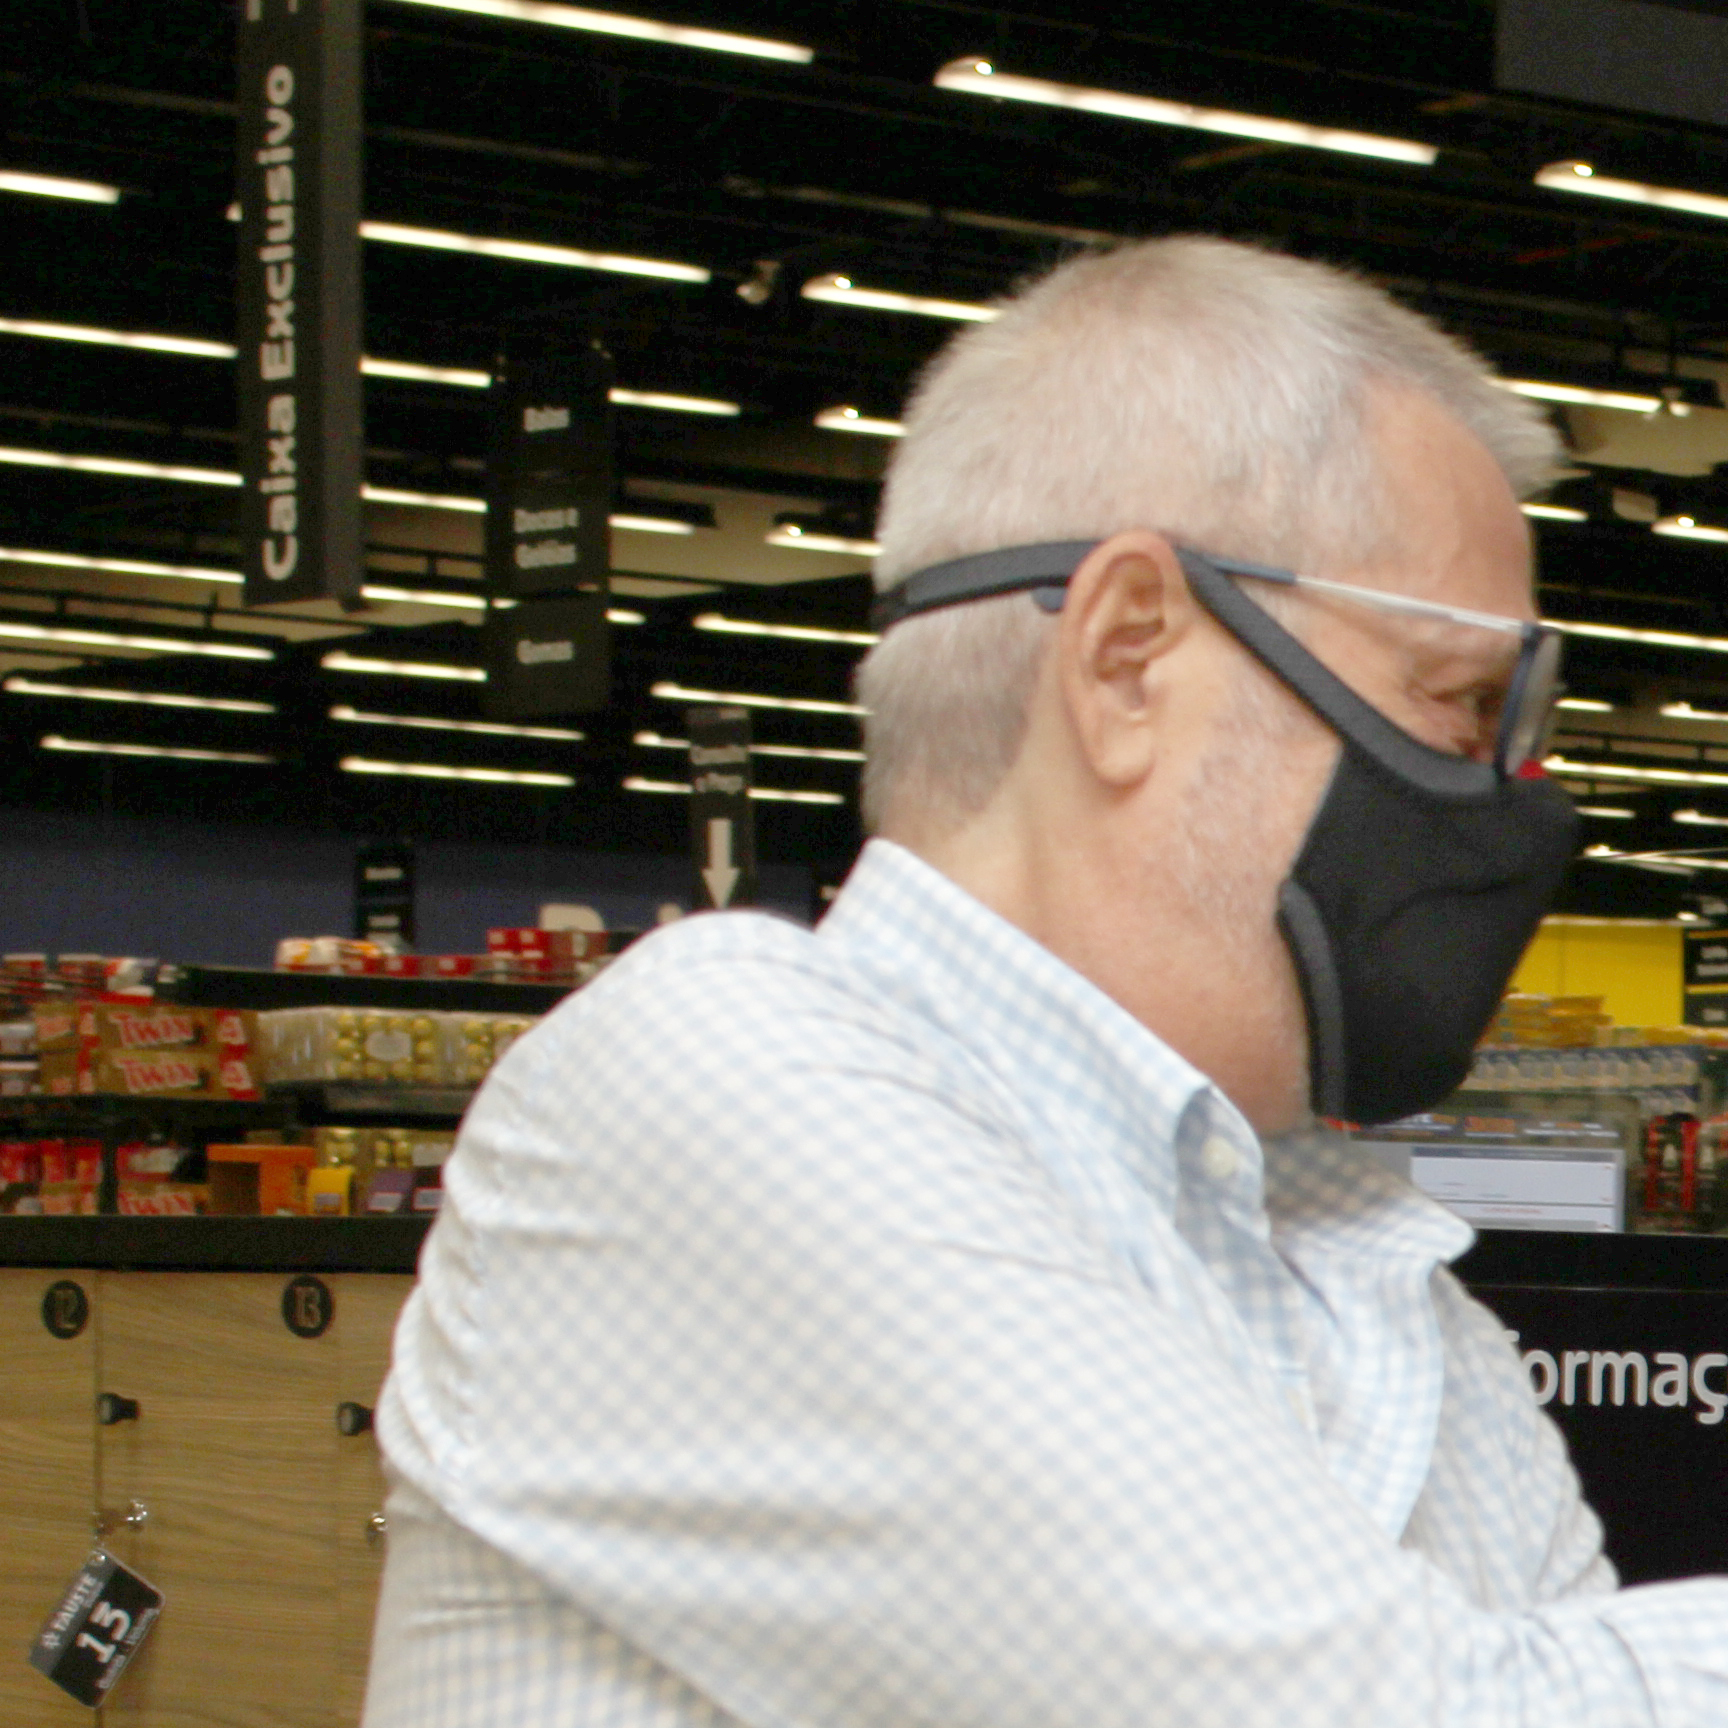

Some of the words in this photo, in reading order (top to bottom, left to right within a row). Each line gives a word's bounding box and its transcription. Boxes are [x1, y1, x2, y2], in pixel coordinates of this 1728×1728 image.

[254, 63, 297, 381] Exclusivo
[257, 393, 298, 582] Caixa
[75, 1601, 131, 1664] 13
